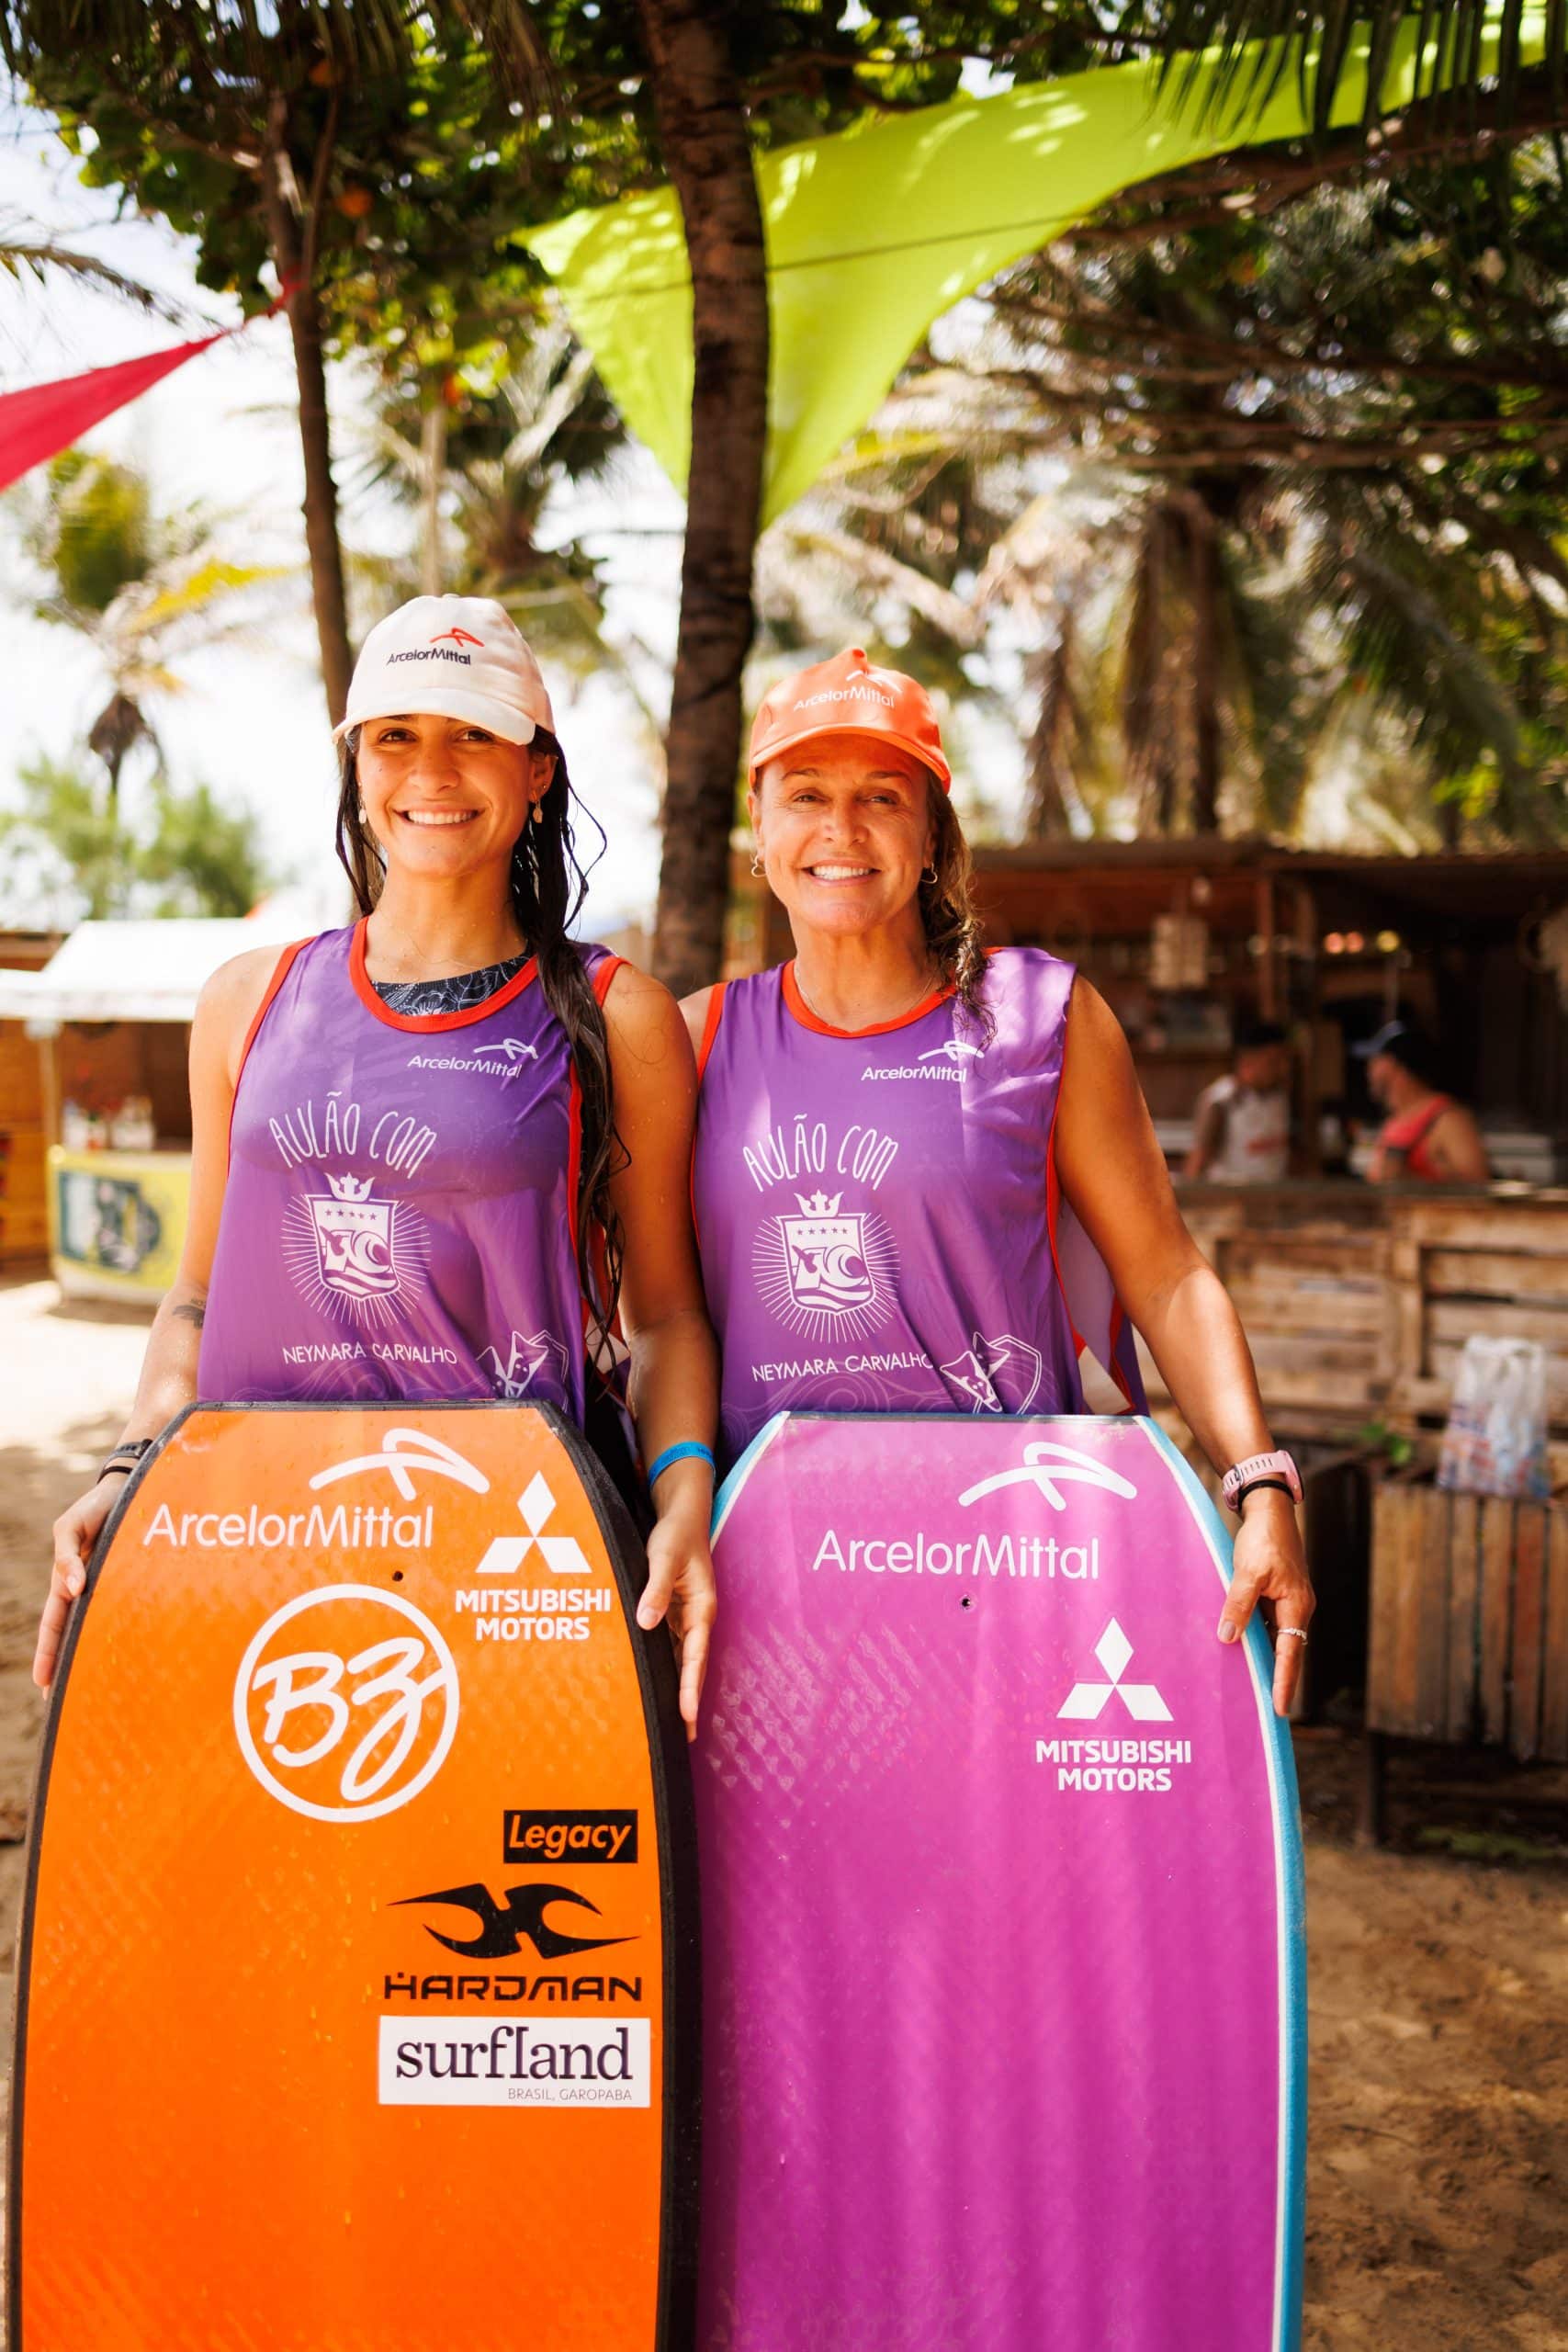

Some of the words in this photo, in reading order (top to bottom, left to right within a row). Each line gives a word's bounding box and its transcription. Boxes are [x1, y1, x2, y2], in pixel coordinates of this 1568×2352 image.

[386, 648, 471, 666] ArcelorMittal
[793, 685, 896, 712] ArcelorMittal
[407, 1055, 523, 1079] ArcelorMittal
[860, 1065, 967, 1084] ArcelorMittal
[268, 1090, 361, 1169] AULÃO
[369, 1110, 438, 1180] COM
[742, 1113, 827, 1193] AULÃO
[837, 1125, 899, 1191] COM
[282, 1341, 367, 1365] NEYMARA
[372, 1342, 457, 1365] CARVALHO
[750, 1357, 839, 1383] NEYMARA
[143, 1503, 434, 1548] ArcelorMittal
[812, 1529, 1100, 1579] ArcelorMittal
[455, 1589, 612, 1613] MITSUBISHI
[475, 1616, 591, 1642] MOTORS
[1035, 1739, 1192, 1765] MITSUBISHI
[1057, 1767, 1173, 1792] MOTORS
[508, 1814, 632, 1860] Legacy
[384, 1972, 642, 2002] HARDMAN
[396, 2025, 634, 2080] surfland
[507, 2087, 556, 2101] BRASIL,
[558, 2087, 633, 2101] GAROPABA
